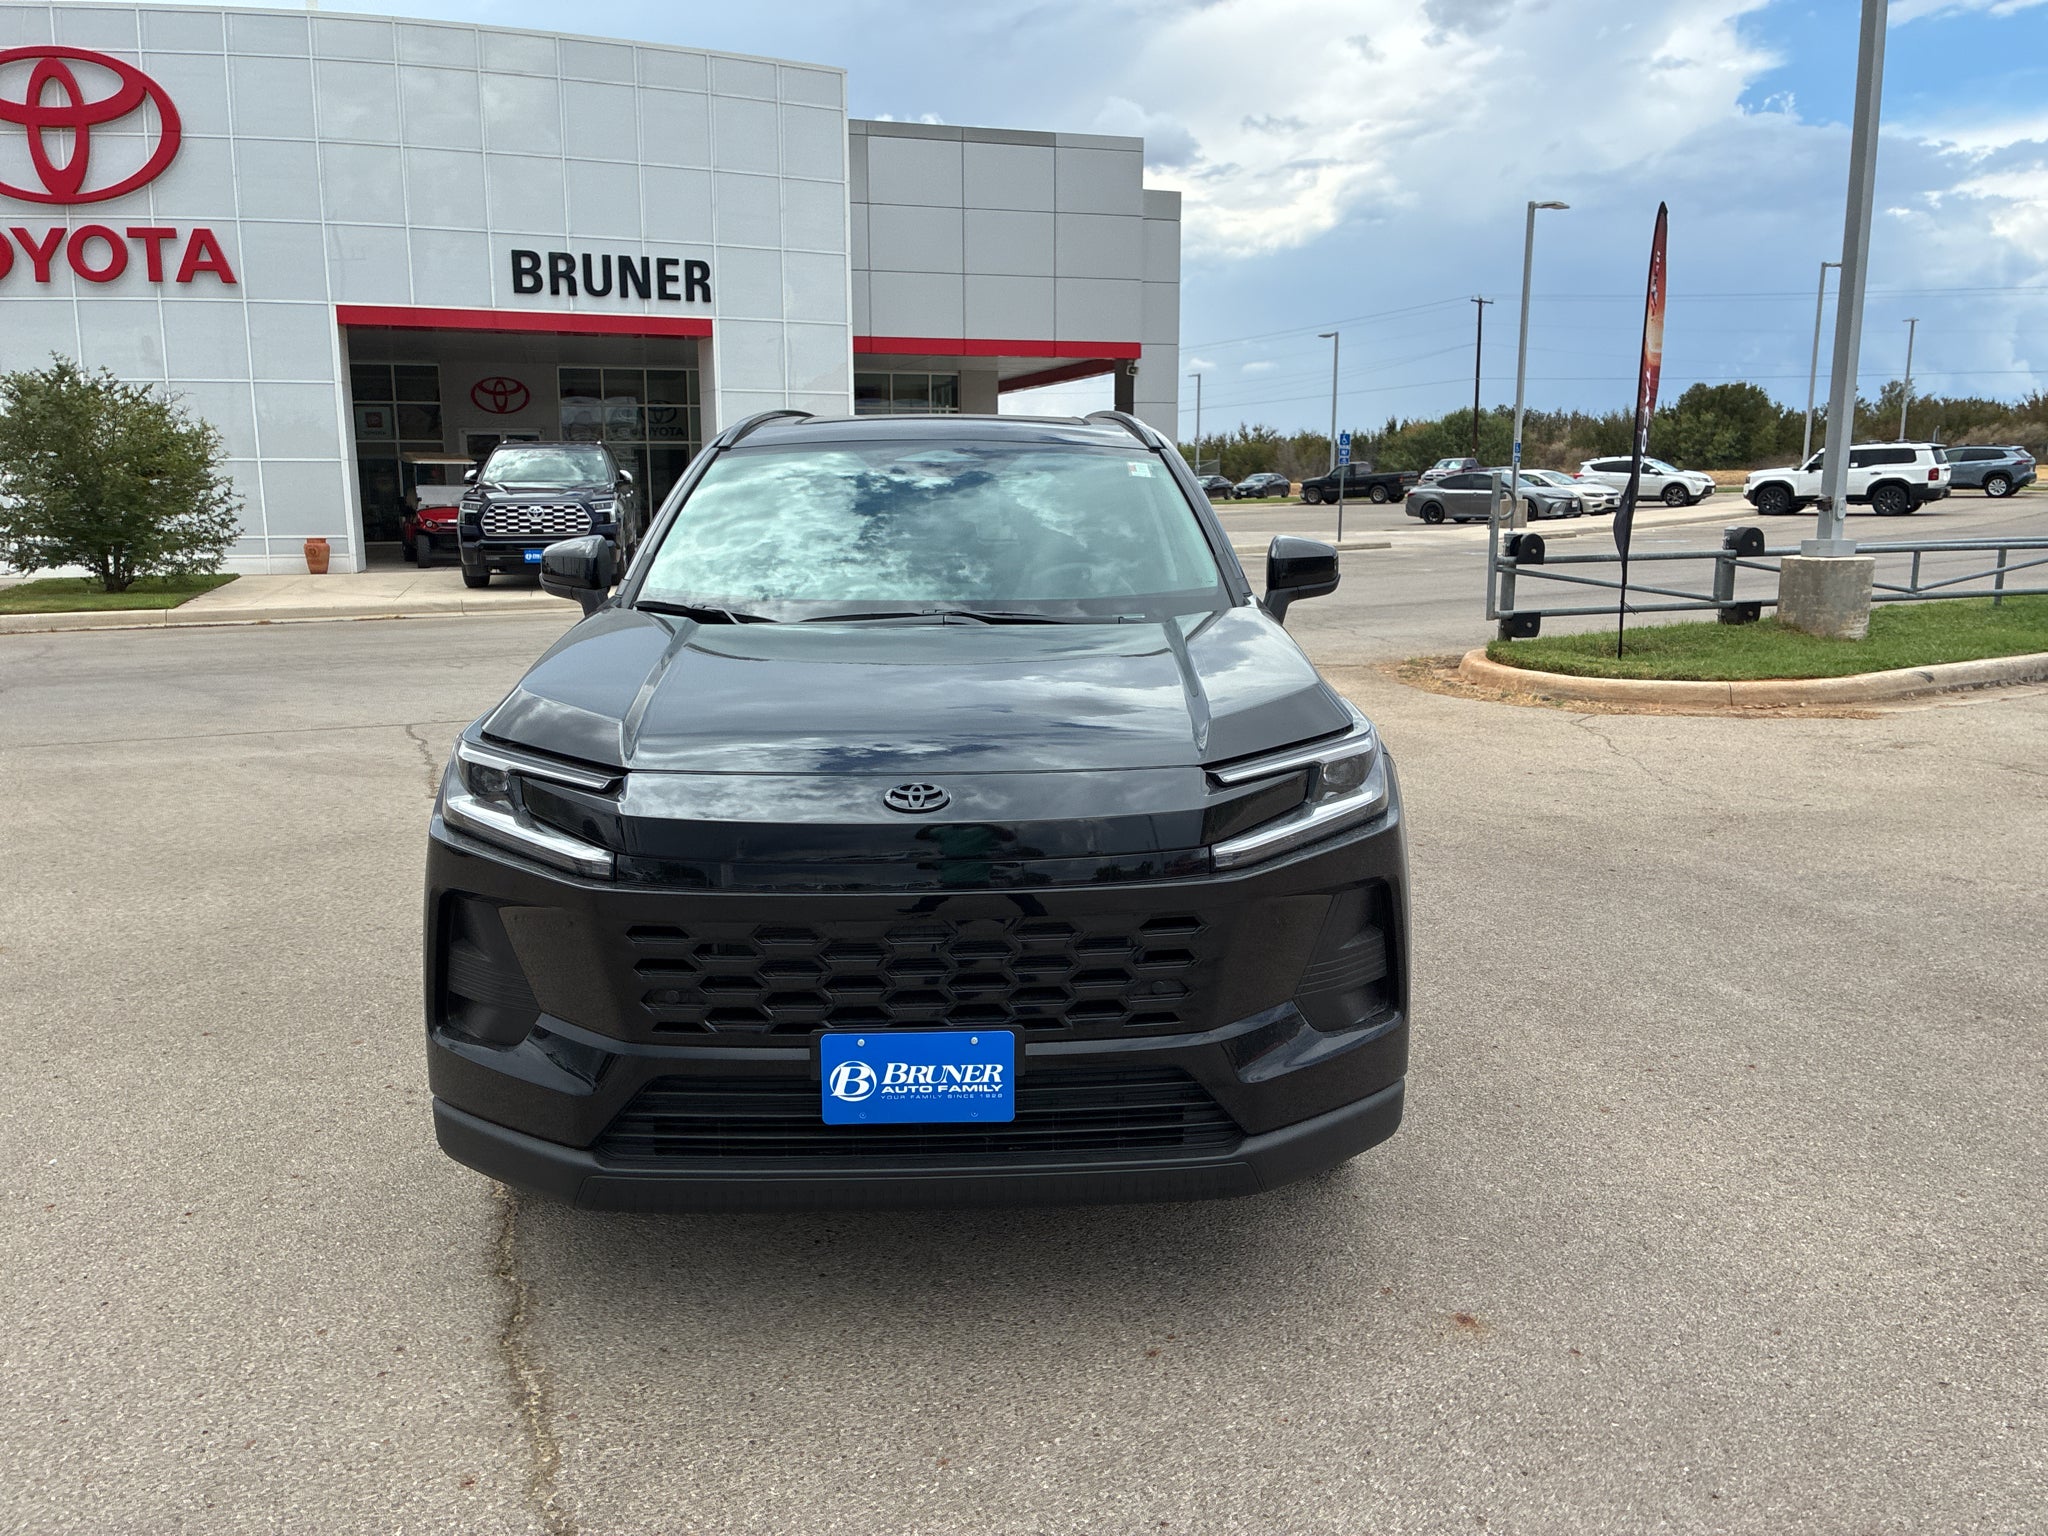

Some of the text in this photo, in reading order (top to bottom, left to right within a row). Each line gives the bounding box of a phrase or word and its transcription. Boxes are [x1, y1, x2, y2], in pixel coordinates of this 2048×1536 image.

[0, 224, 237, 283] YOTA
[511, 249, 712, 303] BRUNER
[881, 1063, 1003, 1084] BRUNER
[938, 1084, 1003, 1092] FAMILY
